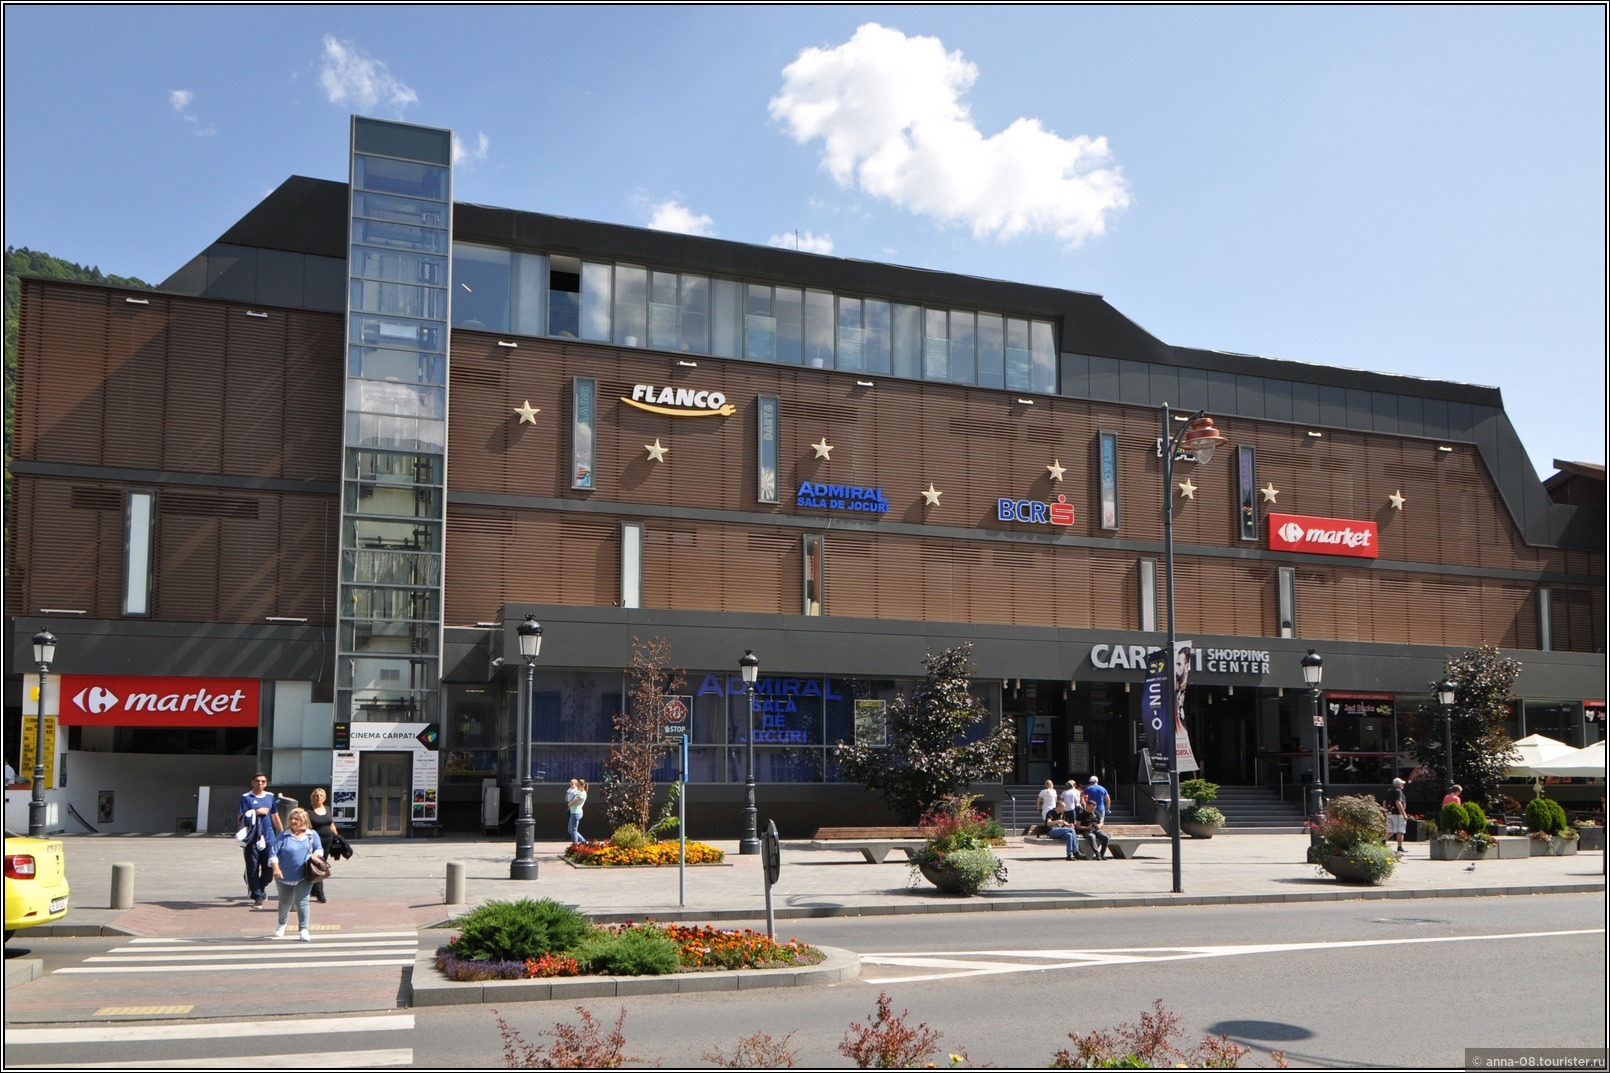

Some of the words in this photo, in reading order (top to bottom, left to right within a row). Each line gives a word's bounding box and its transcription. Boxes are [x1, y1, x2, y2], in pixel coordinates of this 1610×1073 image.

[632, 384, 726, 409] FLANCO
[763, 404, 773, 440] DARTS
[797, 481, 889, 503] ADMIRAL
[797, 498, 827, 508] SALA
[830, 500, 845, 509] DE
[848, 501, 889, 513] JOCURI
[998, 498, 1047, 523] BCR
[1306, 528, 1372, 548] market
[1207, 648, 1270, 662] SHOPPING
[1208, 660, 1270, 674] CENTER
[696, 673, 843, 700] ADMIRAL
[124, 688, 246, 714] market
[752, 700, 797, 712] SALA
[762, 715, 786, 727] DE
